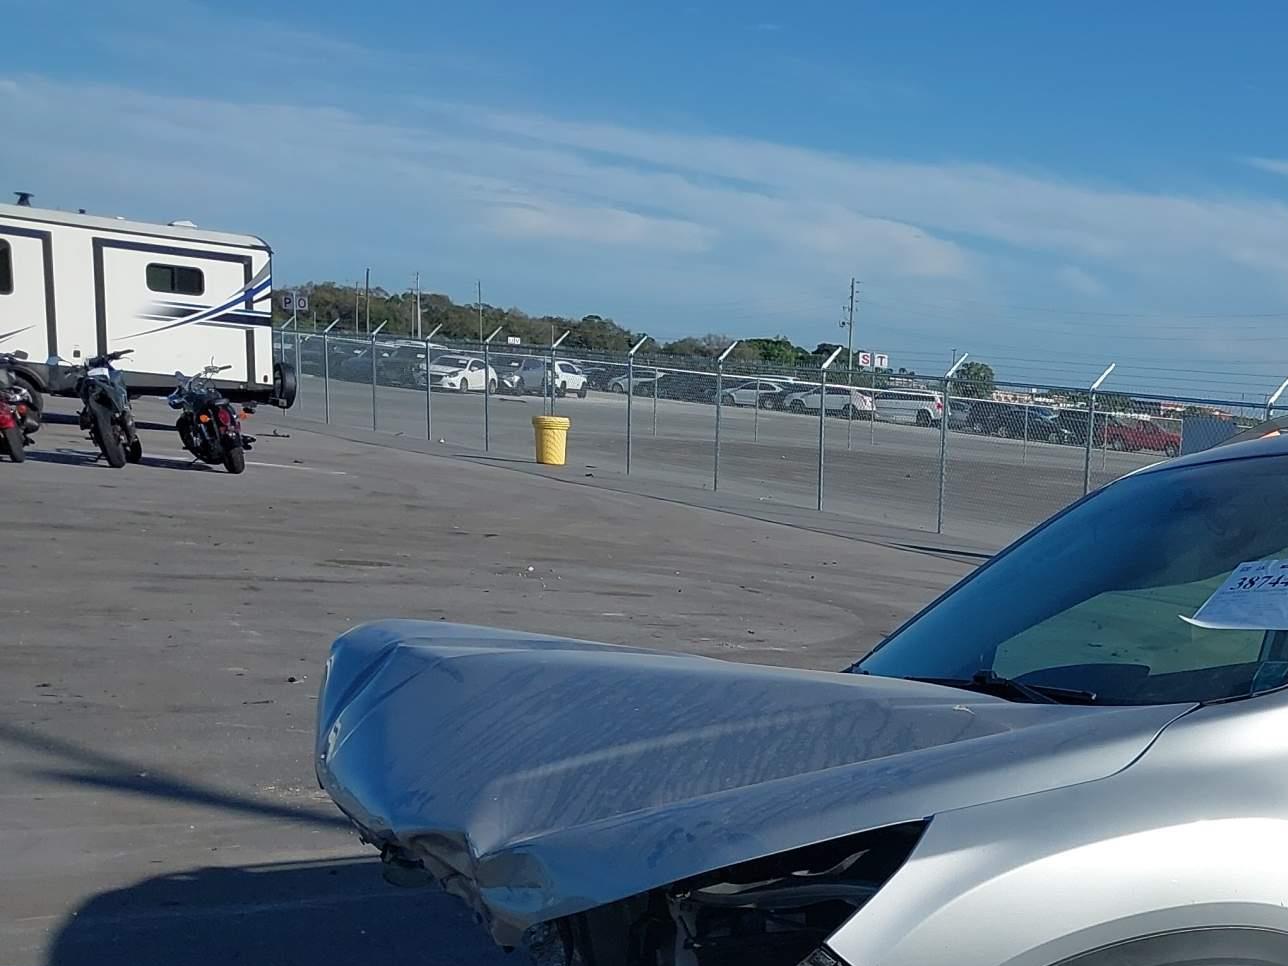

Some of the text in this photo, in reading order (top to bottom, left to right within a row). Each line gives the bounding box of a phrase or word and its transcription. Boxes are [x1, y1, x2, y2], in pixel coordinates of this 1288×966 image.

[284, 297, 292, 308] P
[861, 354, 870, 365] S
[877, 355, 886, 367] T
